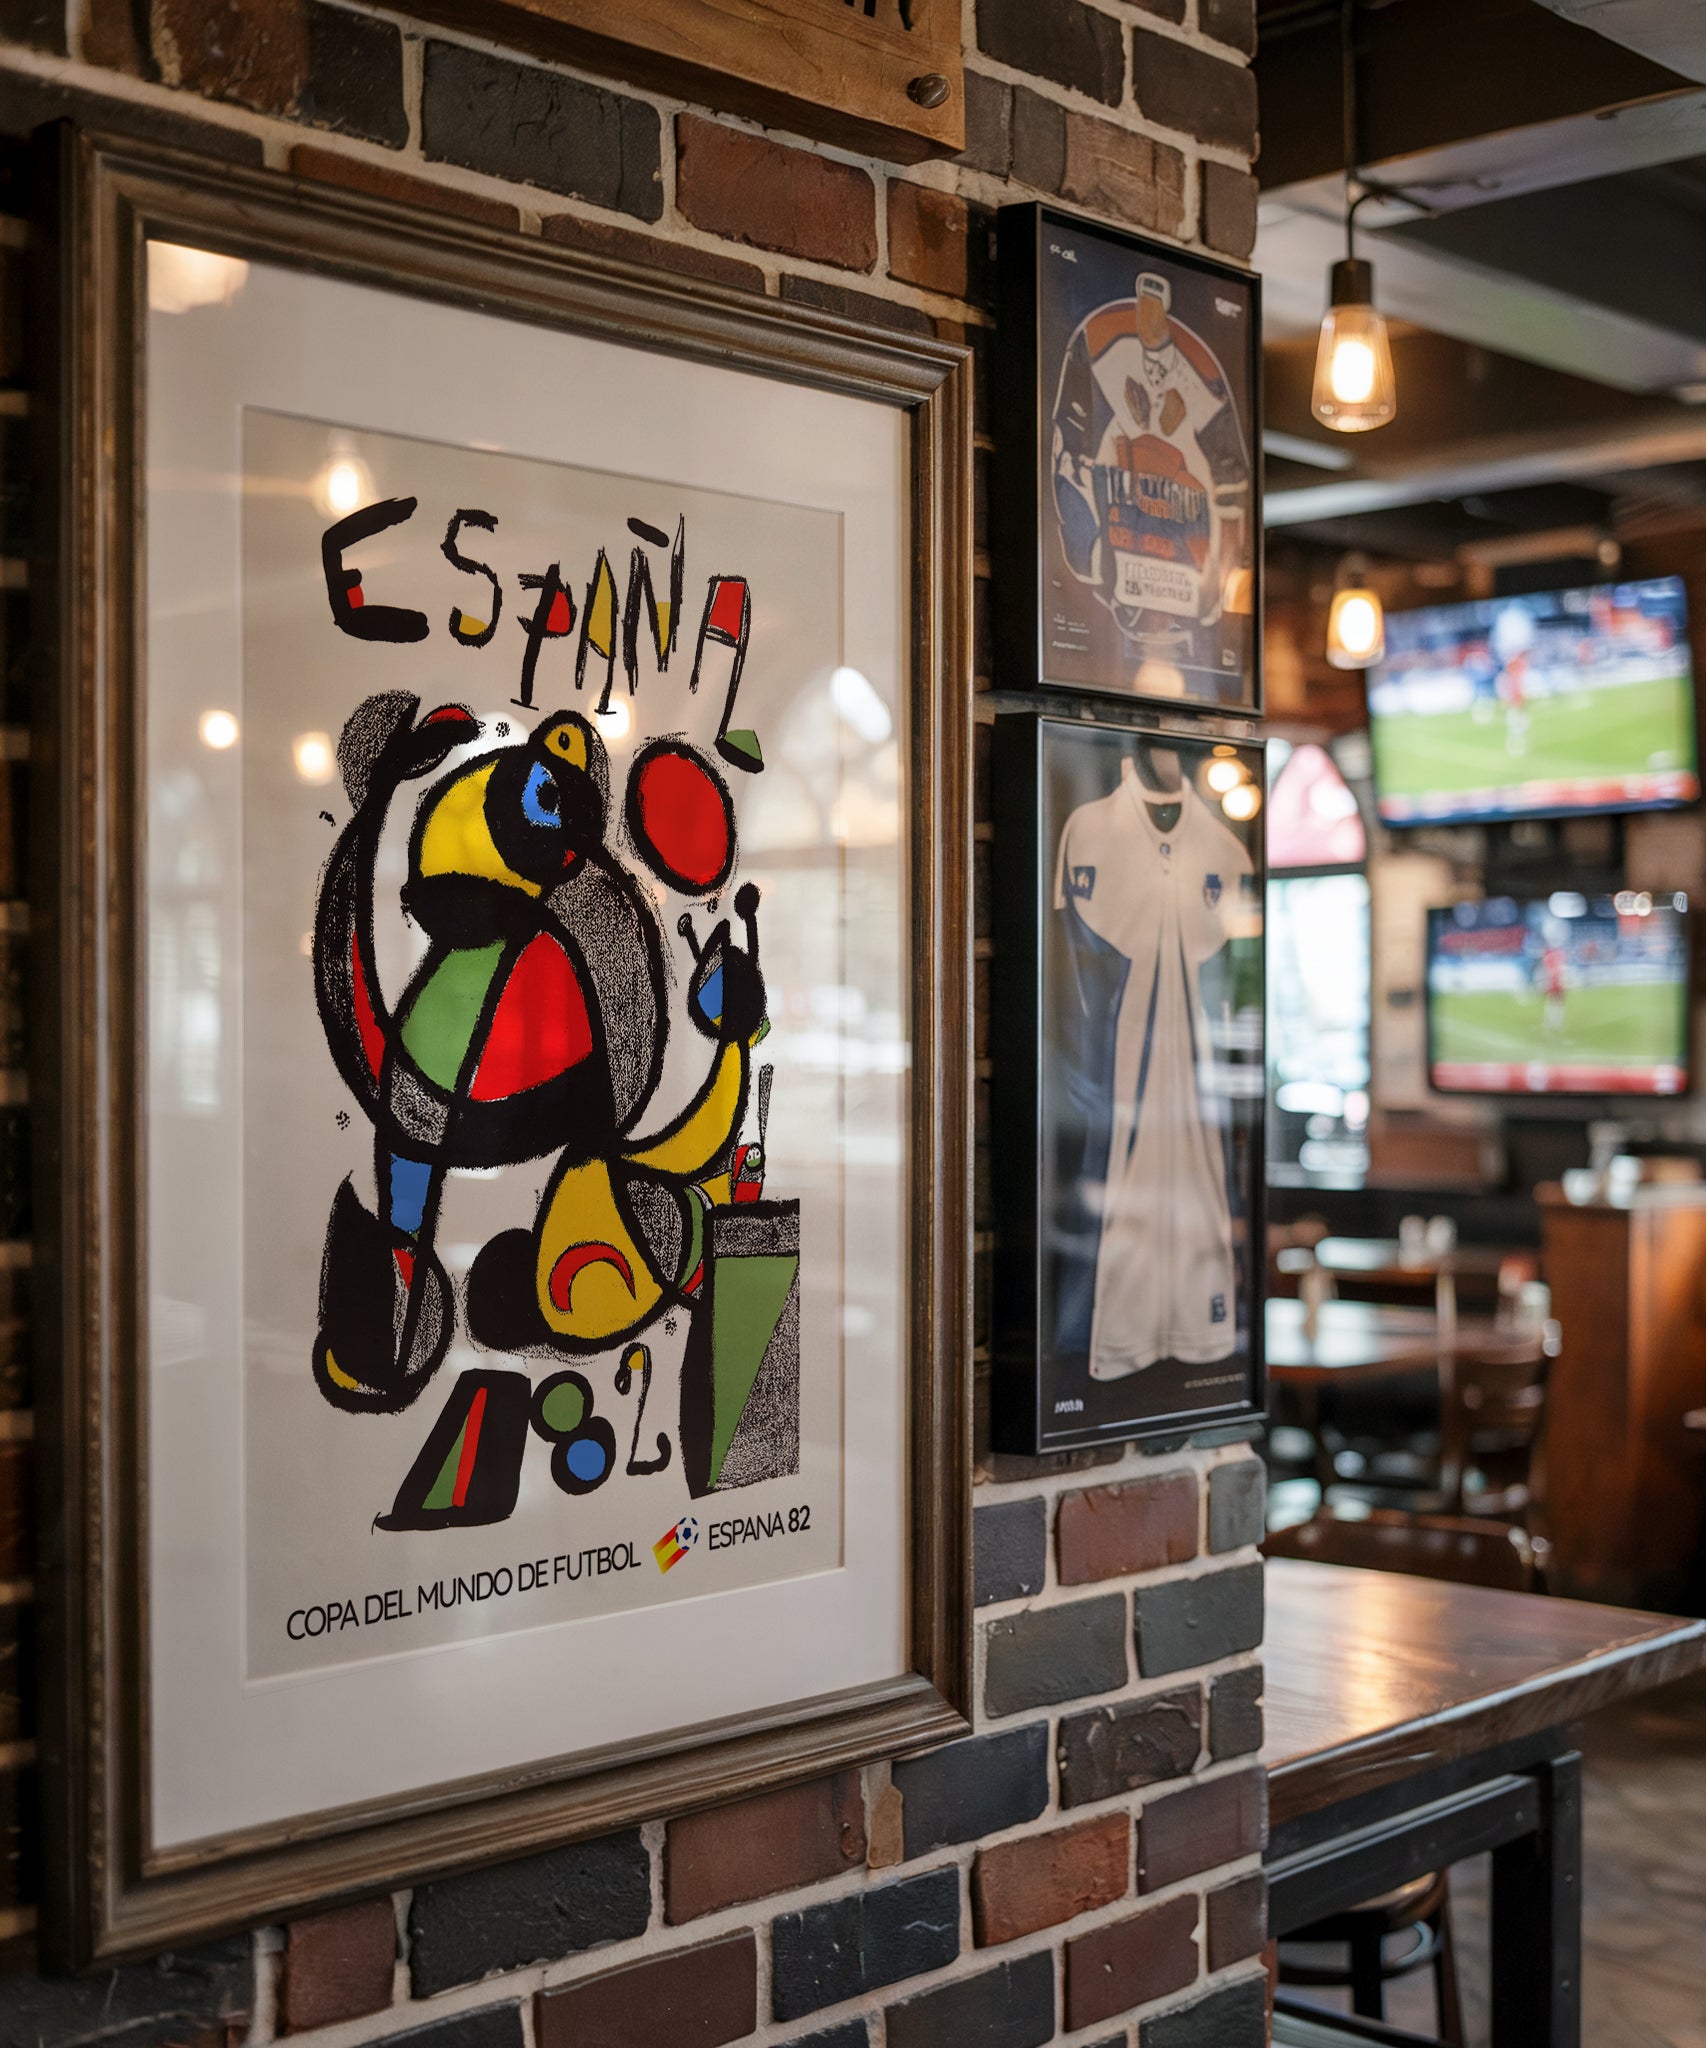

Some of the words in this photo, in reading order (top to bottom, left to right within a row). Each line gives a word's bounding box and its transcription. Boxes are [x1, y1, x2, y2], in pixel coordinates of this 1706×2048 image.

[322, 496, 752, 748] ESPAÑA
[531, 1342, 672, 1496] 82
[286, 1599, 360, 1641] COPA
[364, 1588, 413, 1626] DEL
[417, 1567, 514, 1614] MUNDO
[518, 1558, 549, 1592] DE
[553, 1541, 642, 1585] FUTBOL
[708, 1510, 786, 1551] ESPANA
[787, 1504, 811, 1533] 82
